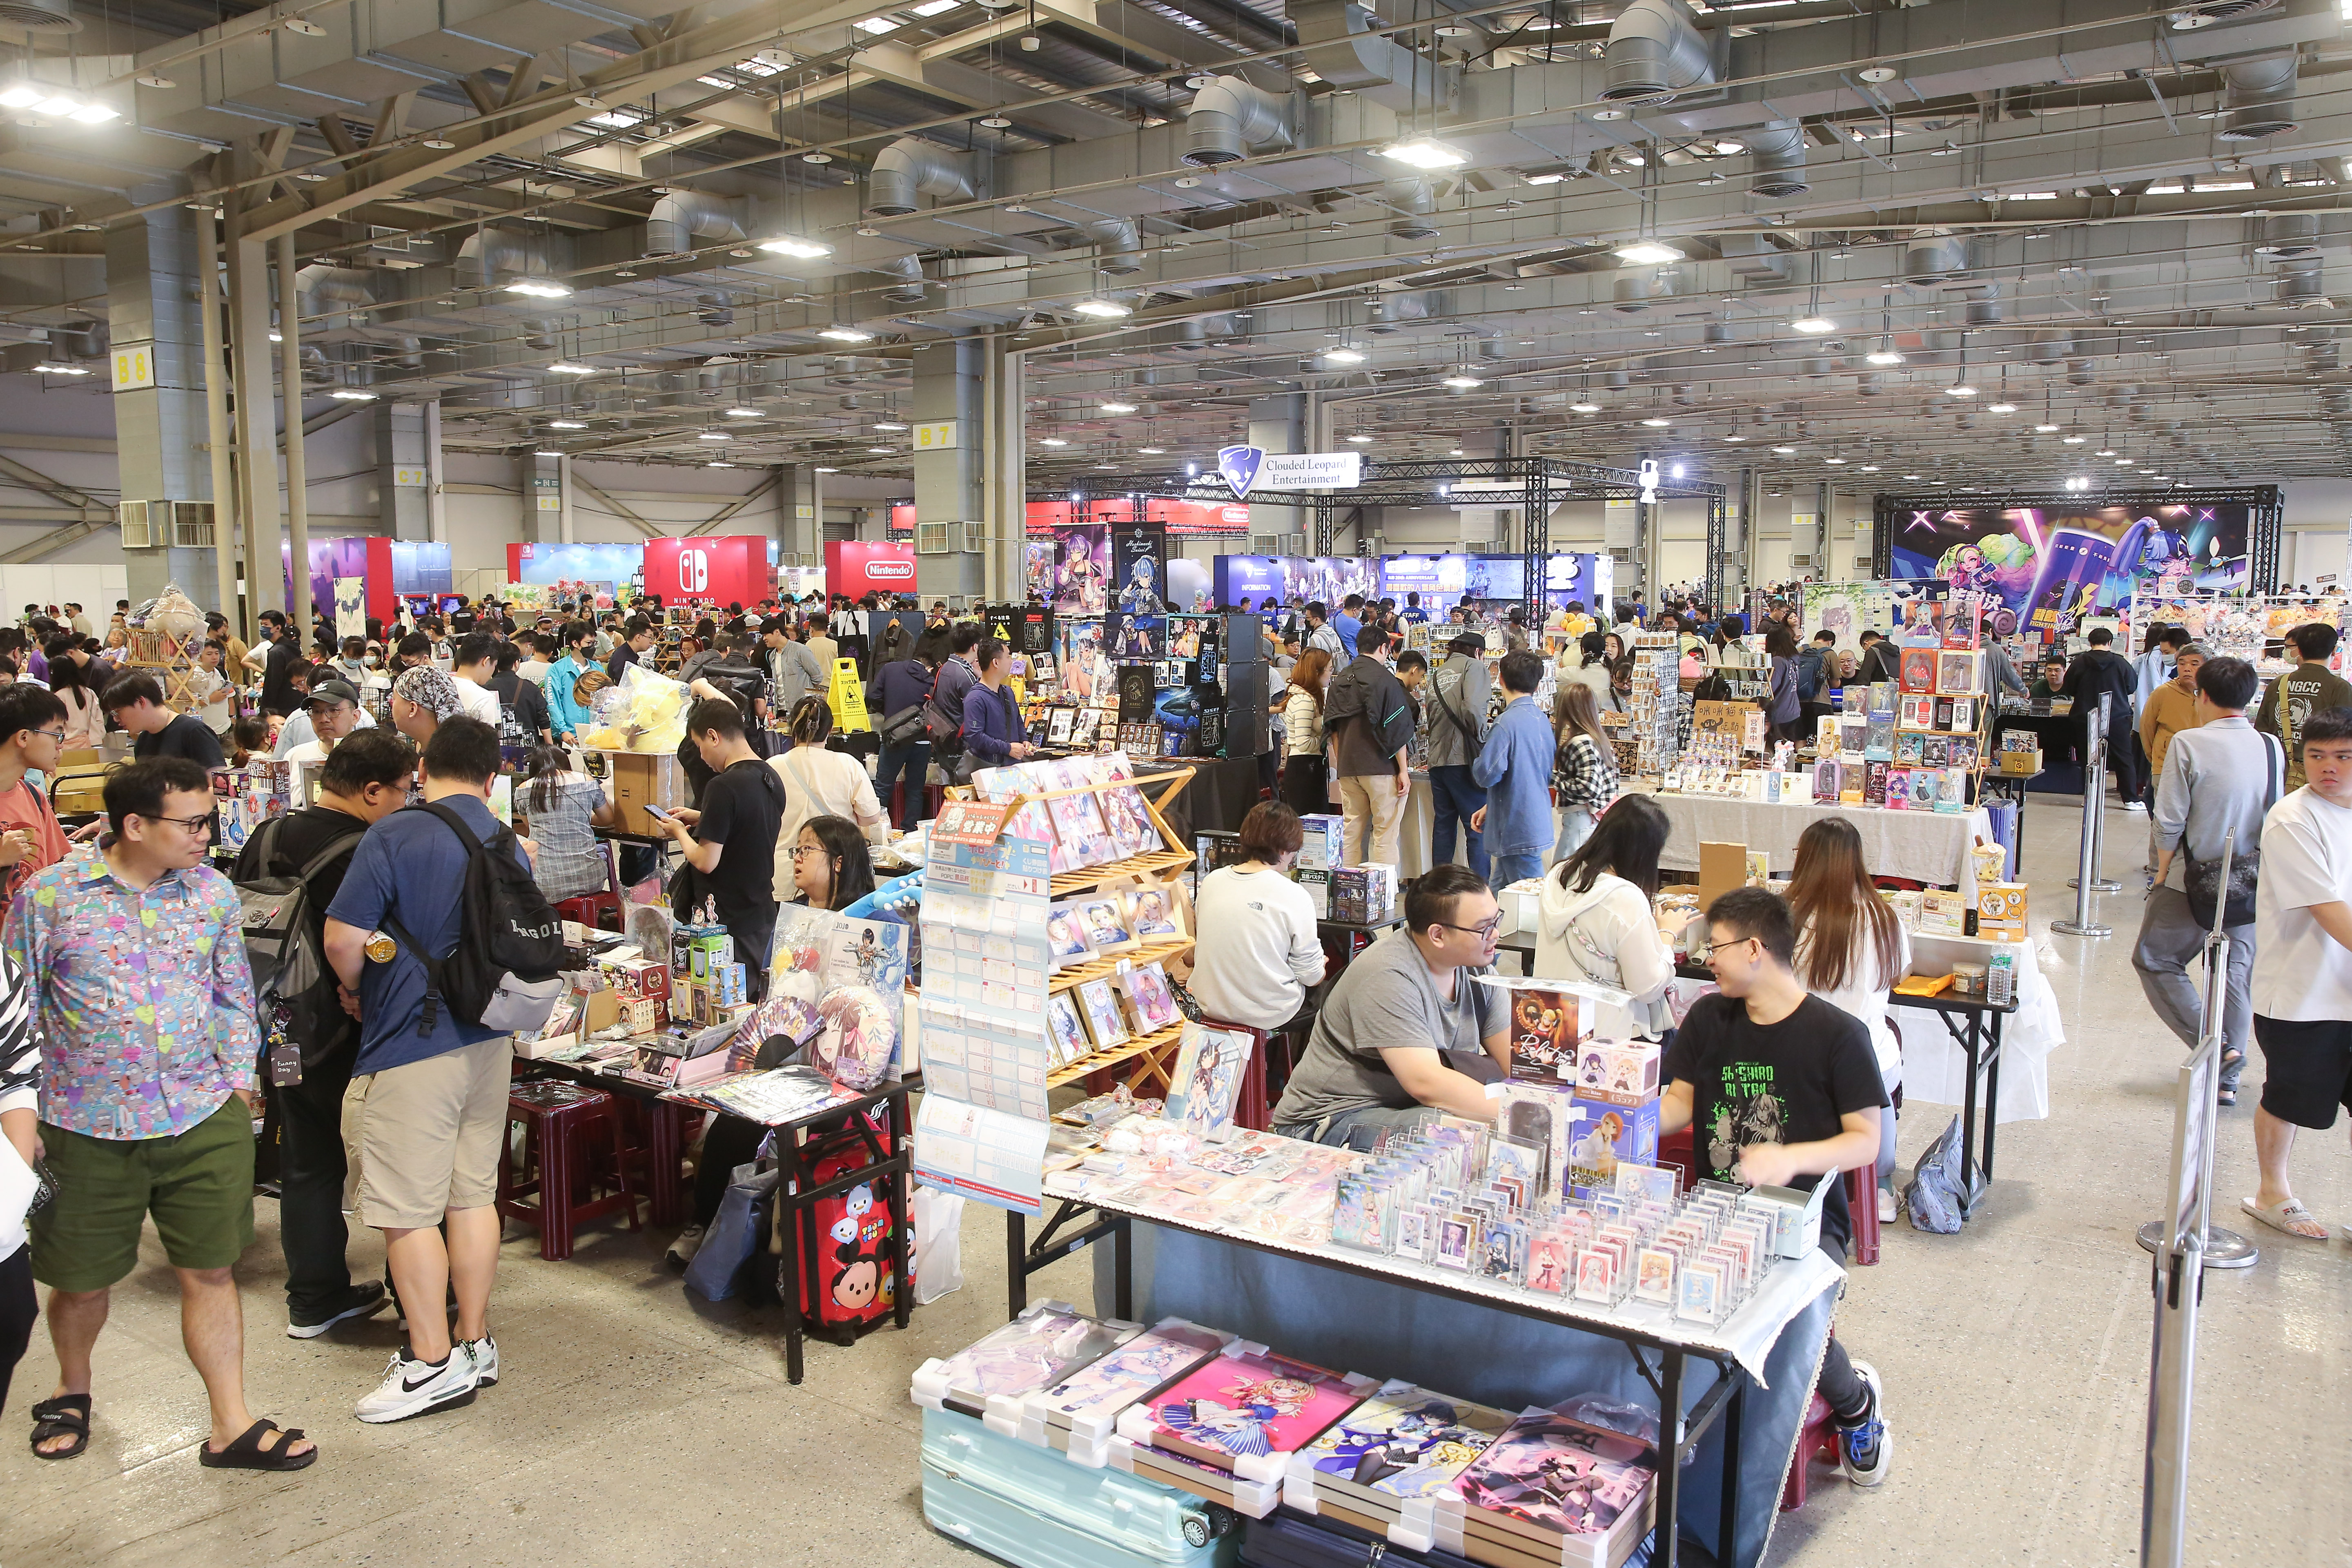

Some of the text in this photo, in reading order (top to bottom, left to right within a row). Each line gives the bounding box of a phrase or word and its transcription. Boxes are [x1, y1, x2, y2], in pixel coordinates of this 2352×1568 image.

[118, 353, 145, 383] B 8
[920, 426, 949, 446] B 7
[1266, 459, 1346, 472] Clouded Leopard
[399, 470, 422, 483] C 7
[1272, 474, 1341, 485] Entertainment
[541, 499, 547, 508] C
[798, 508, 804, 516] C
[1224, 511, 1248, 520] Nintendo
[1728, 507, 1733, 516] 3
[869, 565, 910, 575] Nintendo
[2029, 621, 2060, 630] FIGHTING
[2278, 681, 2321, 693] NGCC
[247, 762, 266, 771] HATSUNE
[962, 819, 997, 835] 営業中
[862, 1218, 884, 1235] TSUM
